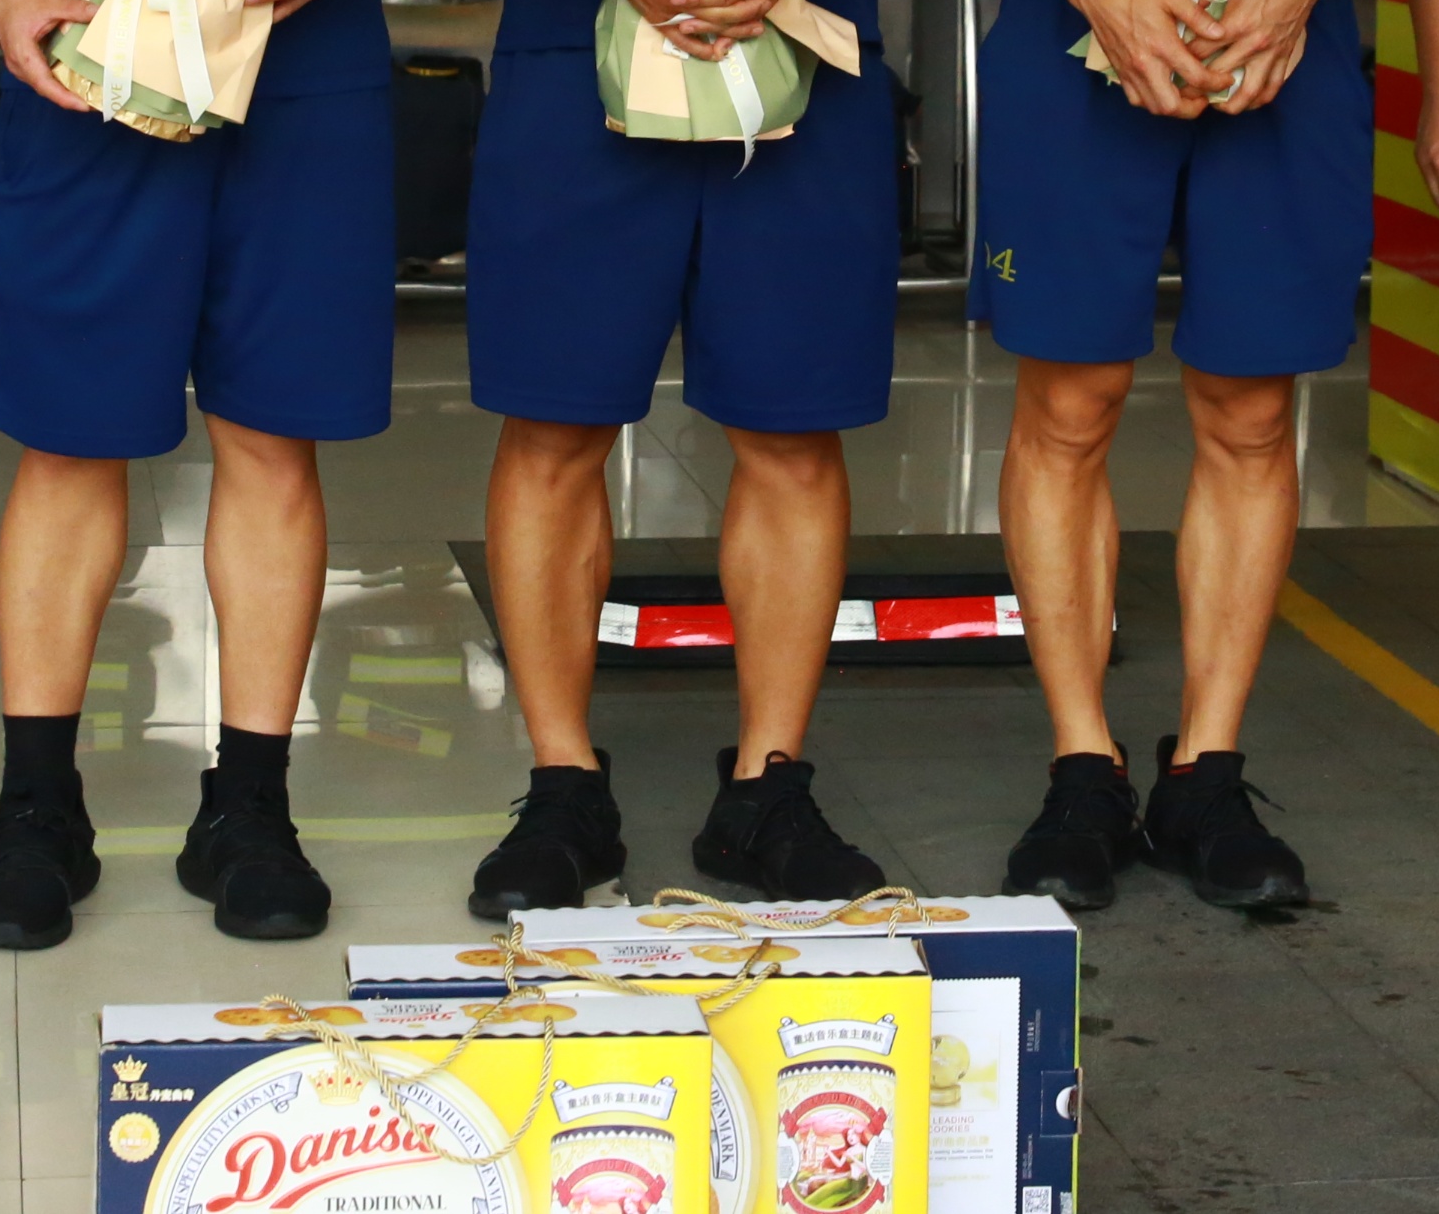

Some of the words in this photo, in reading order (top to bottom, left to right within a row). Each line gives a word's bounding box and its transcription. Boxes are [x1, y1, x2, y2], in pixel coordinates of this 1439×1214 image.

[220, 1095, 262, 1129] FOODS
[710, 1089, 735, 1164] DENMARK
[206, 1104, 447, 1213] Danisa
[324, 1194, 448, 1213] TRADITIONAL
